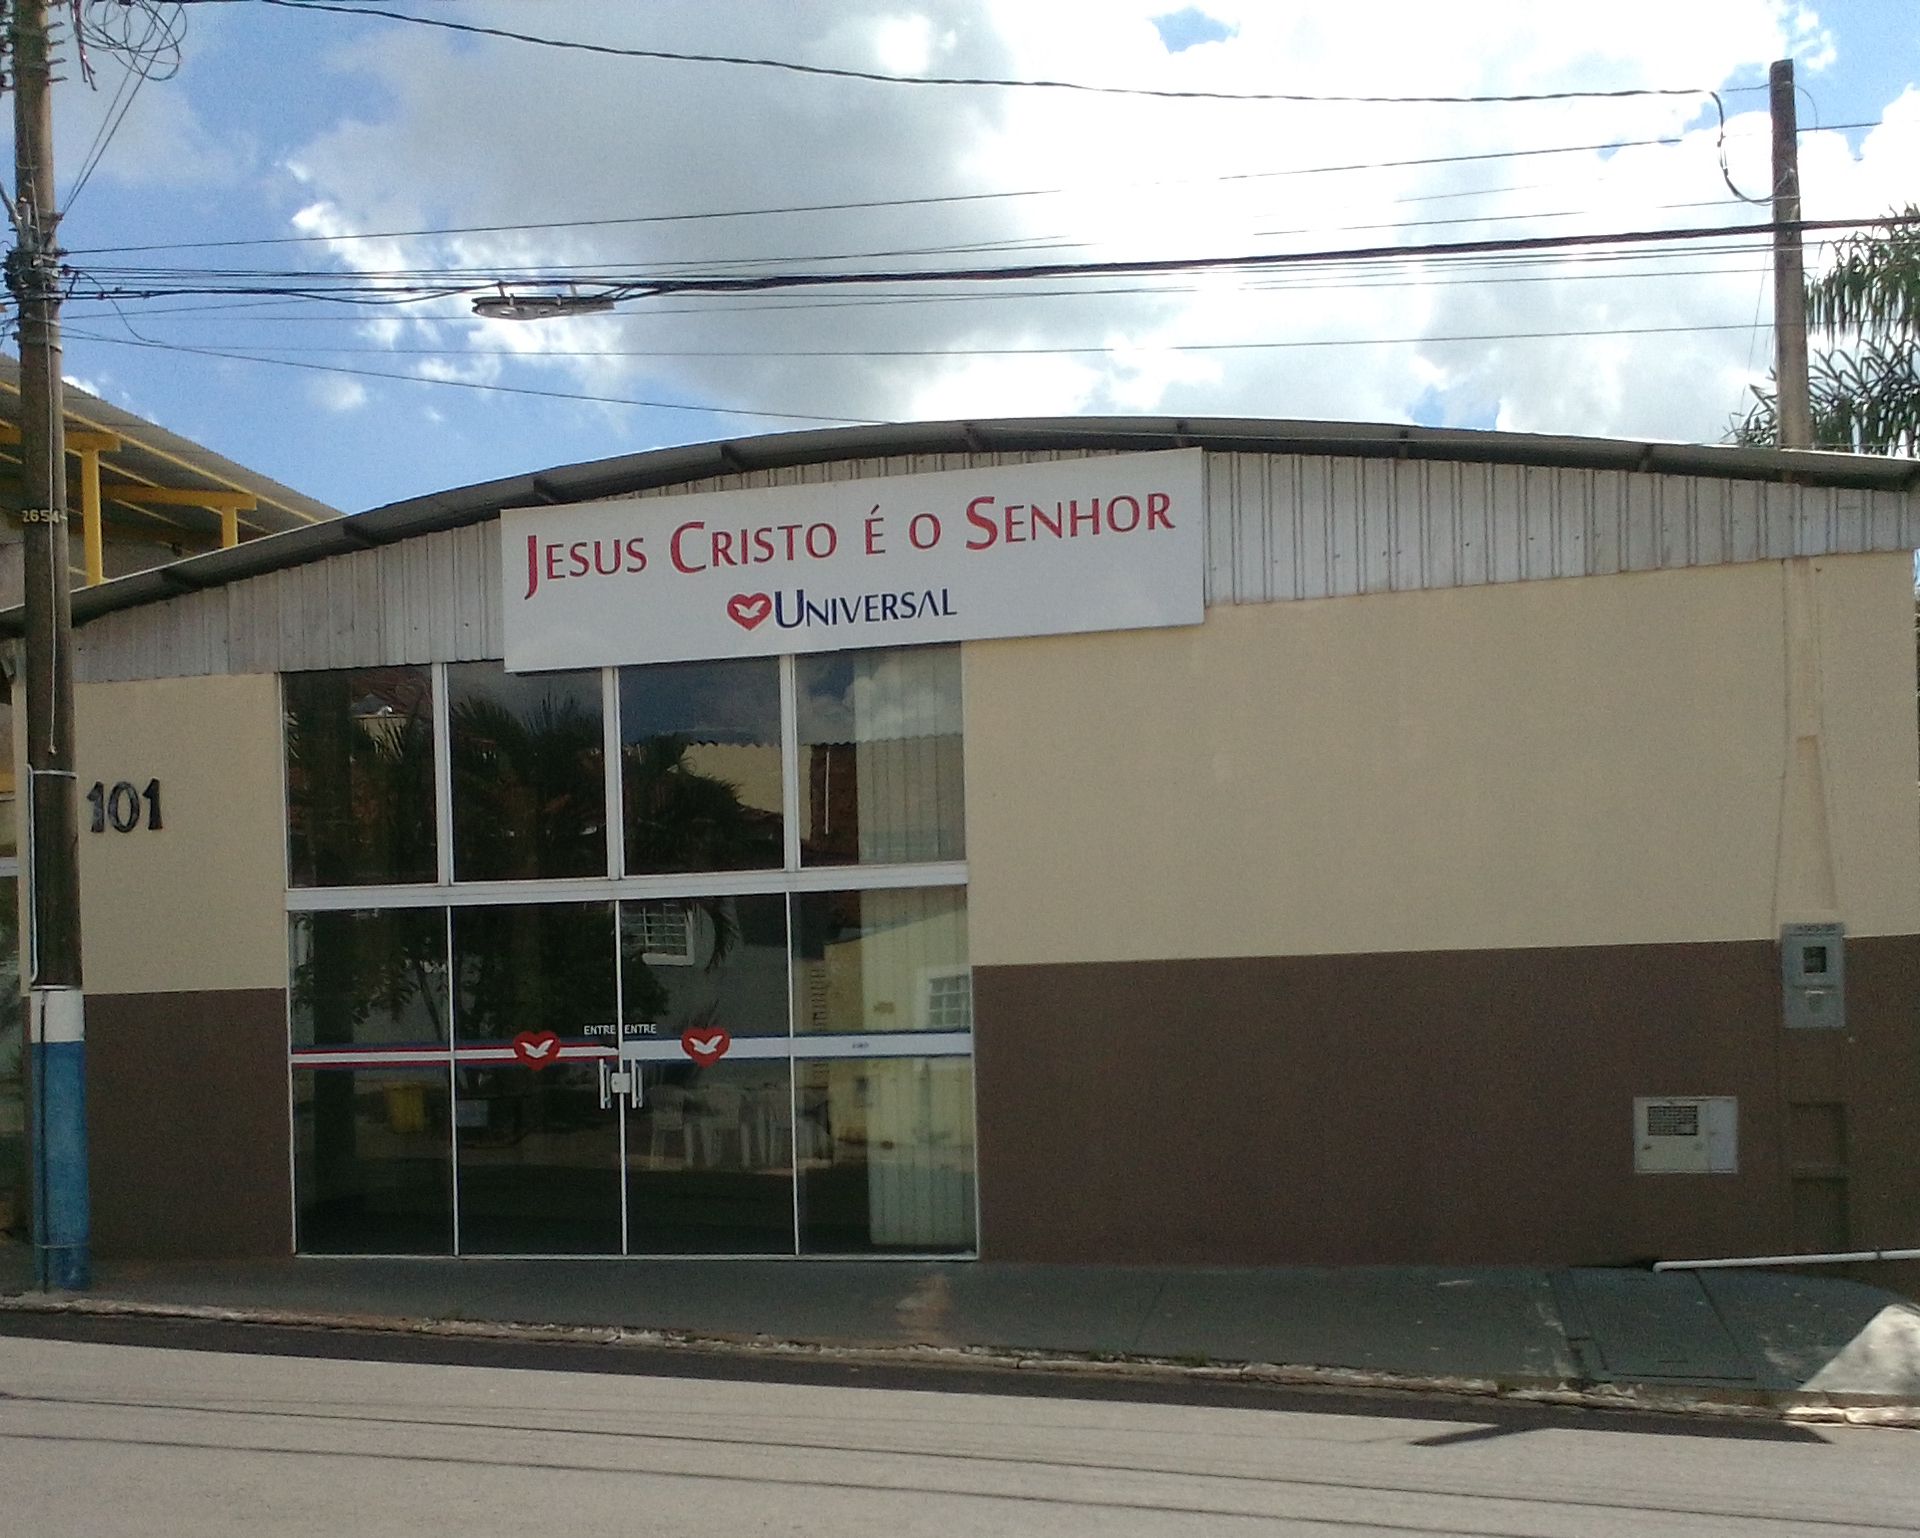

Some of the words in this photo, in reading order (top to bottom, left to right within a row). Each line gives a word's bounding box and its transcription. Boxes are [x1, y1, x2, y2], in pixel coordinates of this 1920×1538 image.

[525, 534, 649, 599] JESUS
[669, 520, 838, 574] CRISTO
[864, 504, 887, 555] É
[908, 512, 942, 550] O
[965, 491, 1175, 551] SENHOR
[774, 588, 958, 629] UNIVERSAL
[86, 777, 163, 834] 101
[584, 1025, 616, 1035] ENTRE
[624, 1023, 657, 1034] ENTRE
